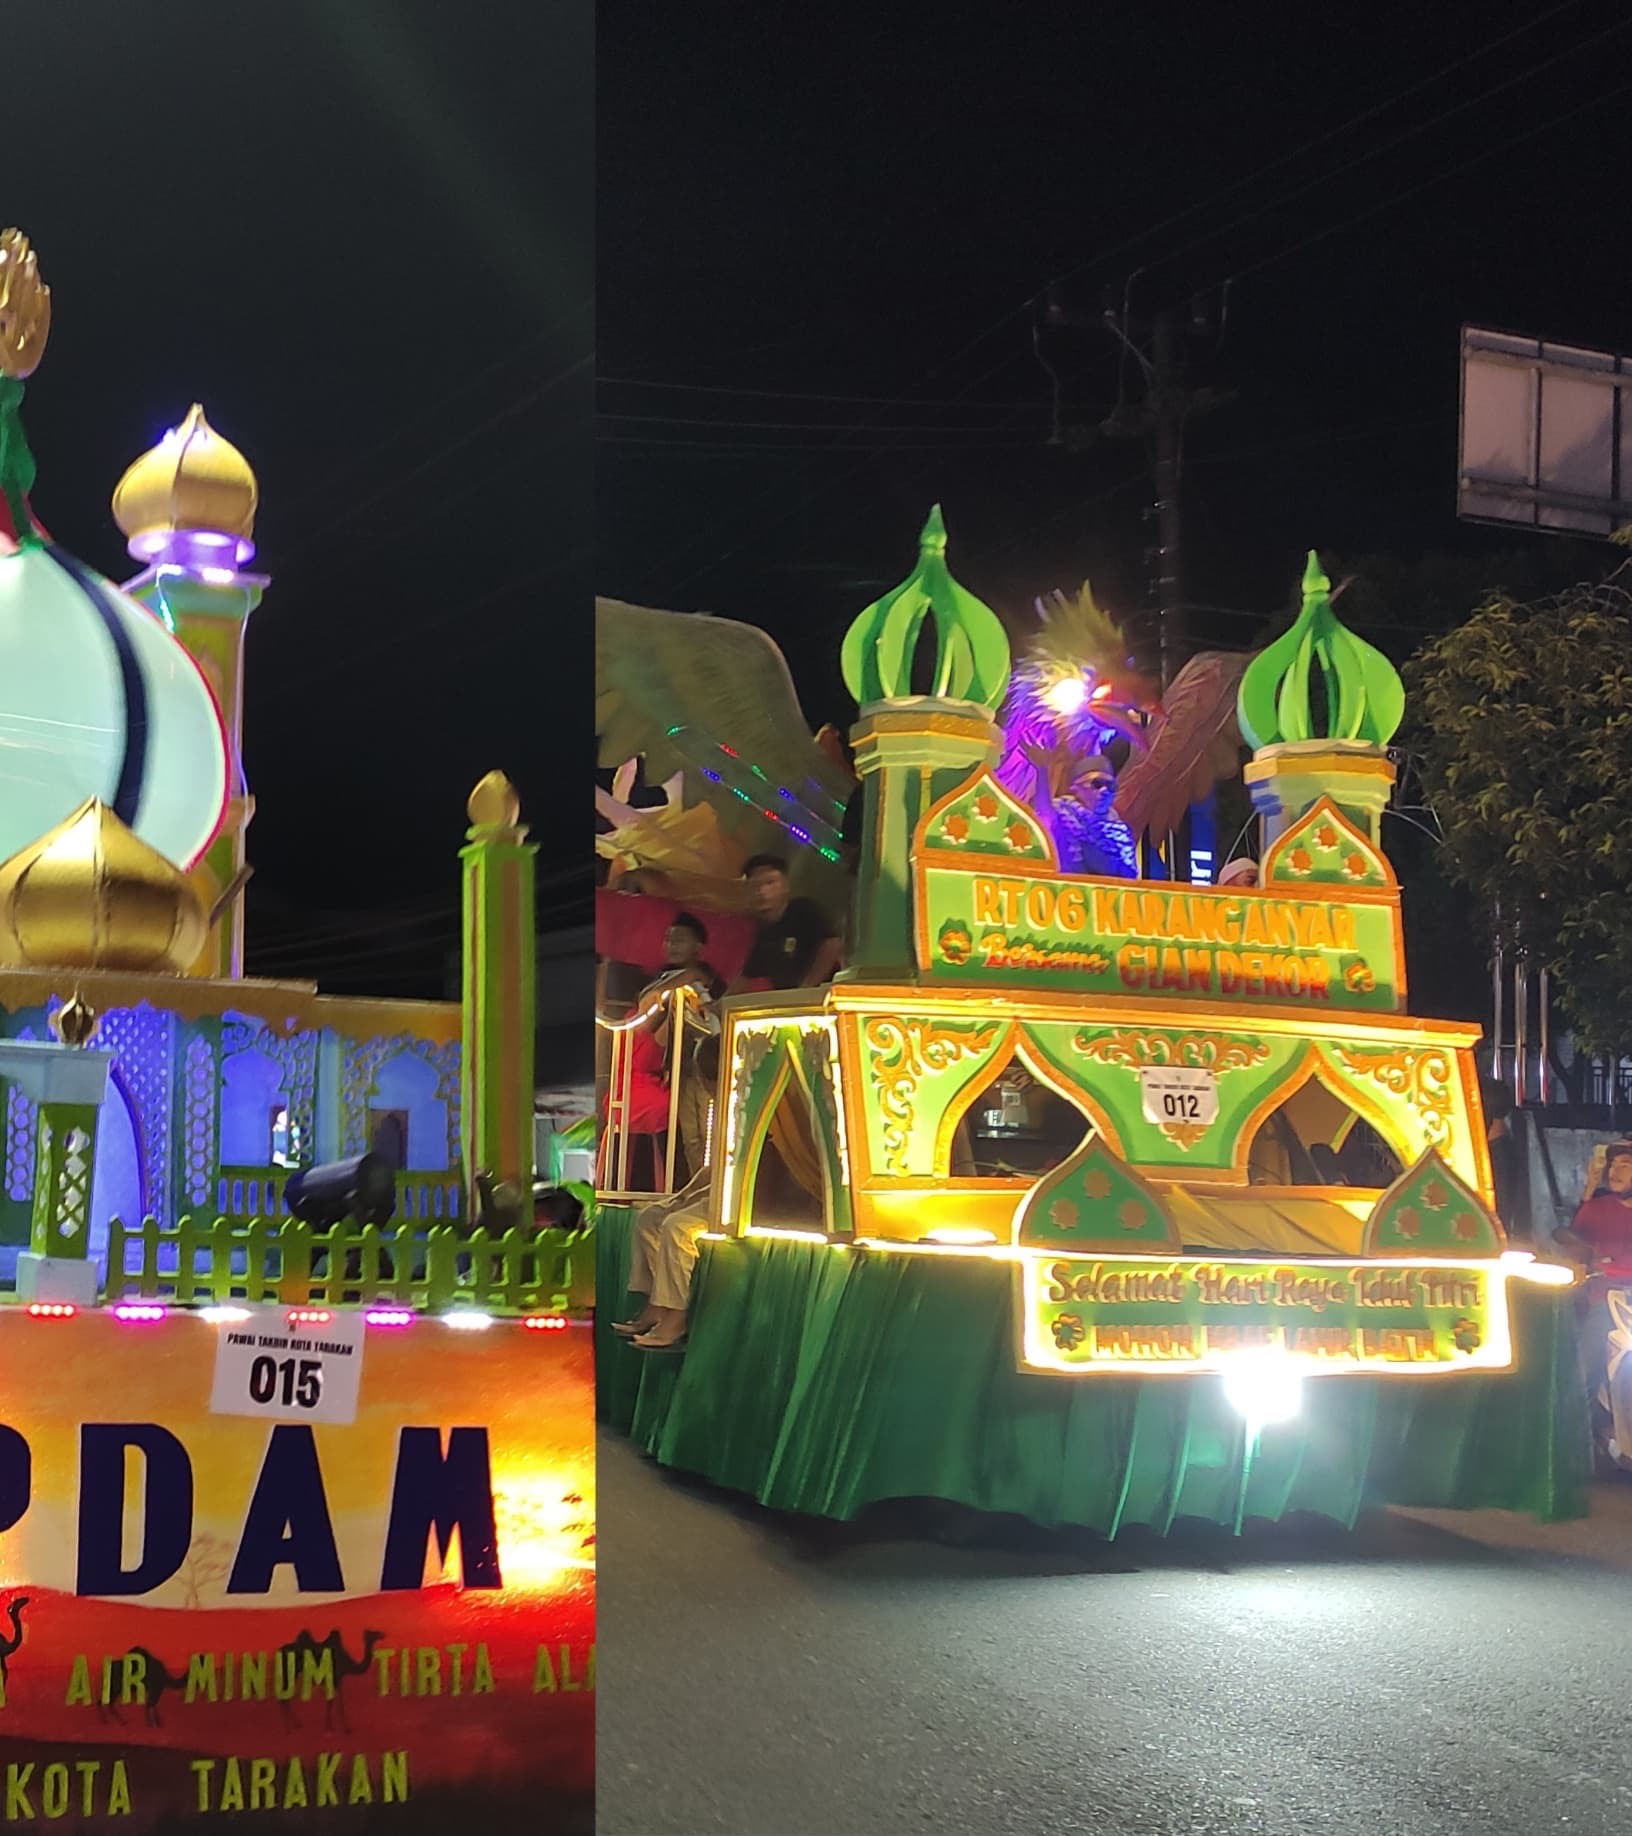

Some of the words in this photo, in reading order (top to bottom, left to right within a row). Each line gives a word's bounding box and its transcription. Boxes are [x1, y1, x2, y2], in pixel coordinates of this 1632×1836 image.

[1216, 950, 1331, 999] DEKOR
[1164, 1094, 1200, 1117] 012
[1048, 1261, 1185, 1304] Selamat
[1190, 1263, 1269, 1304] Hari
[1269, 1265, 1348, 1312] Raya
[1348, 1266, 1416, 1308] Idul
[227, 1333, 256, 1346] PAWAI
[249, 1355, 324, 1408] 015
[65, 1653, 147, 1707] AIR
[184, 1648, 335, 1703] MINUM
[371, 1643, 494, 1697] TIRTA
[5, 1759, 132, 1820] KOTA
[190, 1750, 409, 1812] TARAKAN
